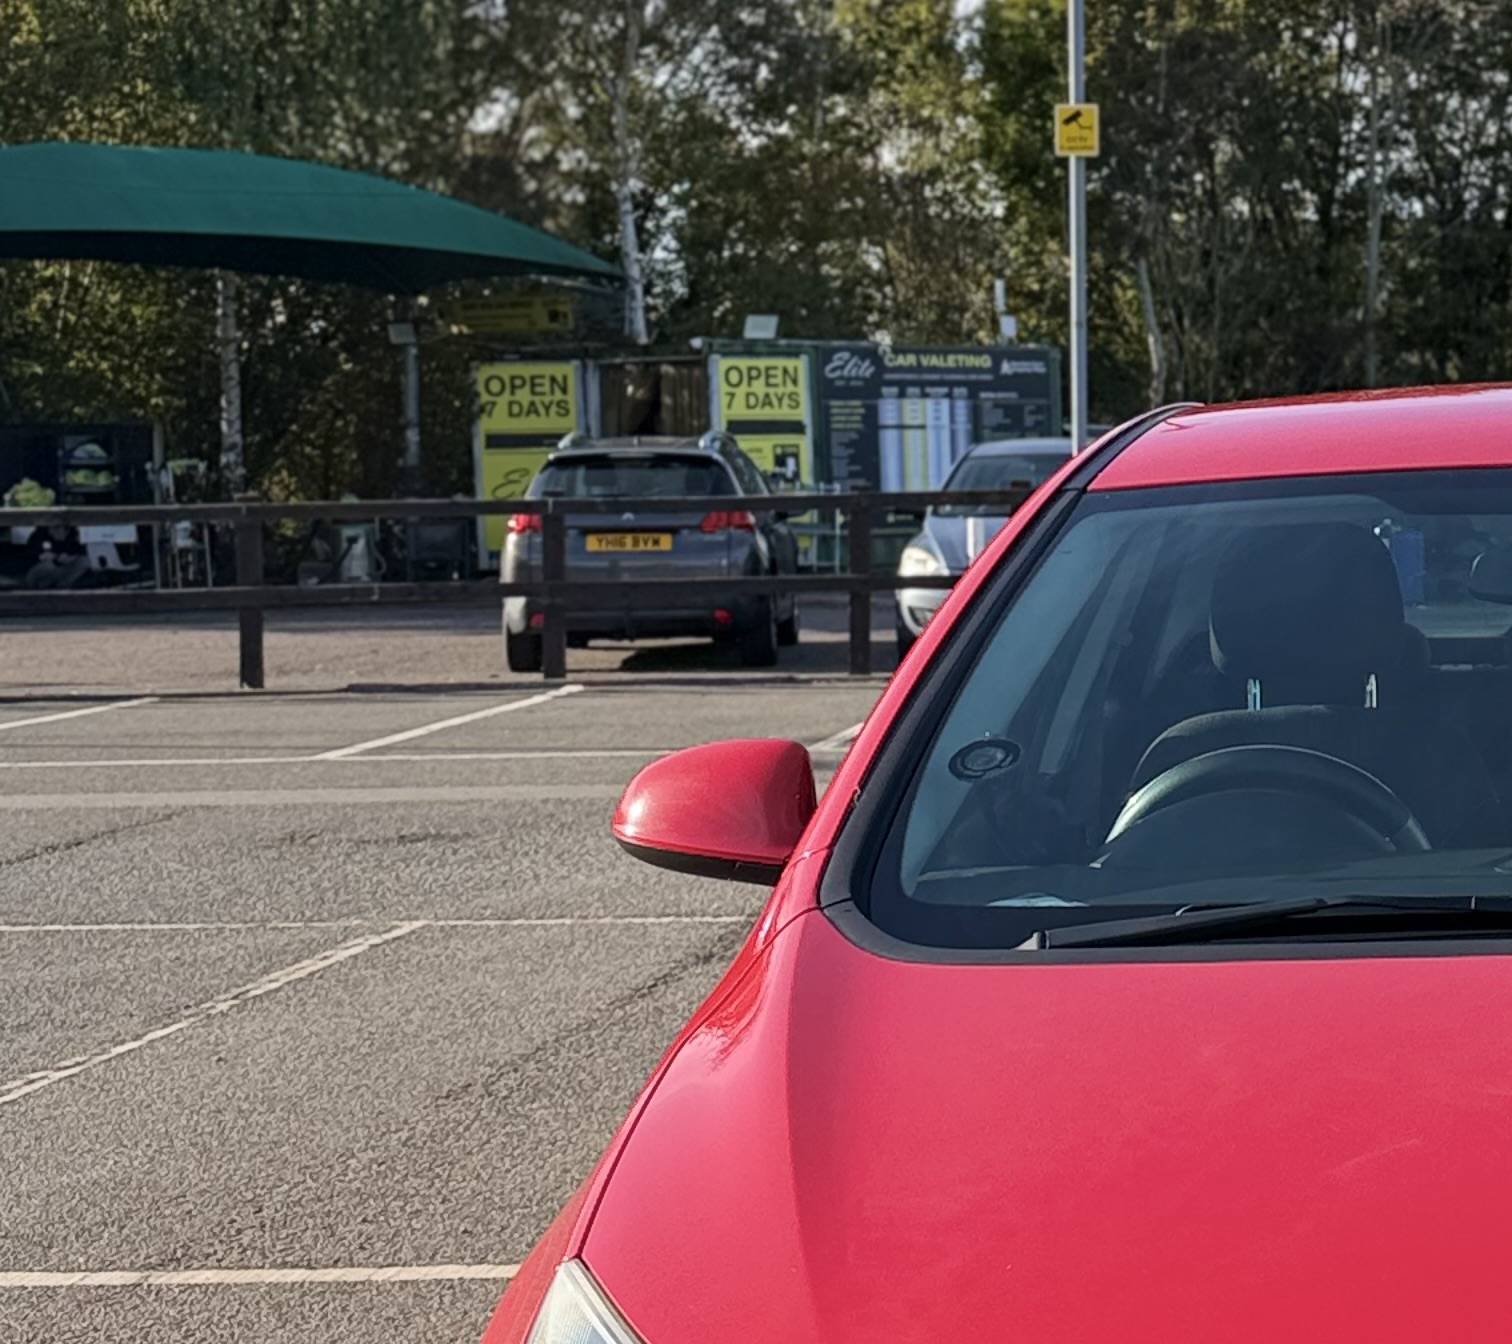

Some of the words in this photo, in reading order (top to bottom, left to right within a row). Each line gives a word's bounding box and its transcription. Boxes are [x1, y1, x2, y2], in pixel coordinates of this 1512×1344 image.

[824, 351, 876, 378] Elite
[883, 354, 917, 368] CAR
[920, 354, 992, 368] VALETING
[484, 374, 569, 397] OPEN
[725, 365, 799, 389] OPEN
[485, 399, 498, 419] 7
[507, 399, 571, 419] DAYS
[725, 391, 737, 411] 7
[745, 391, 801, 410] DAYS
